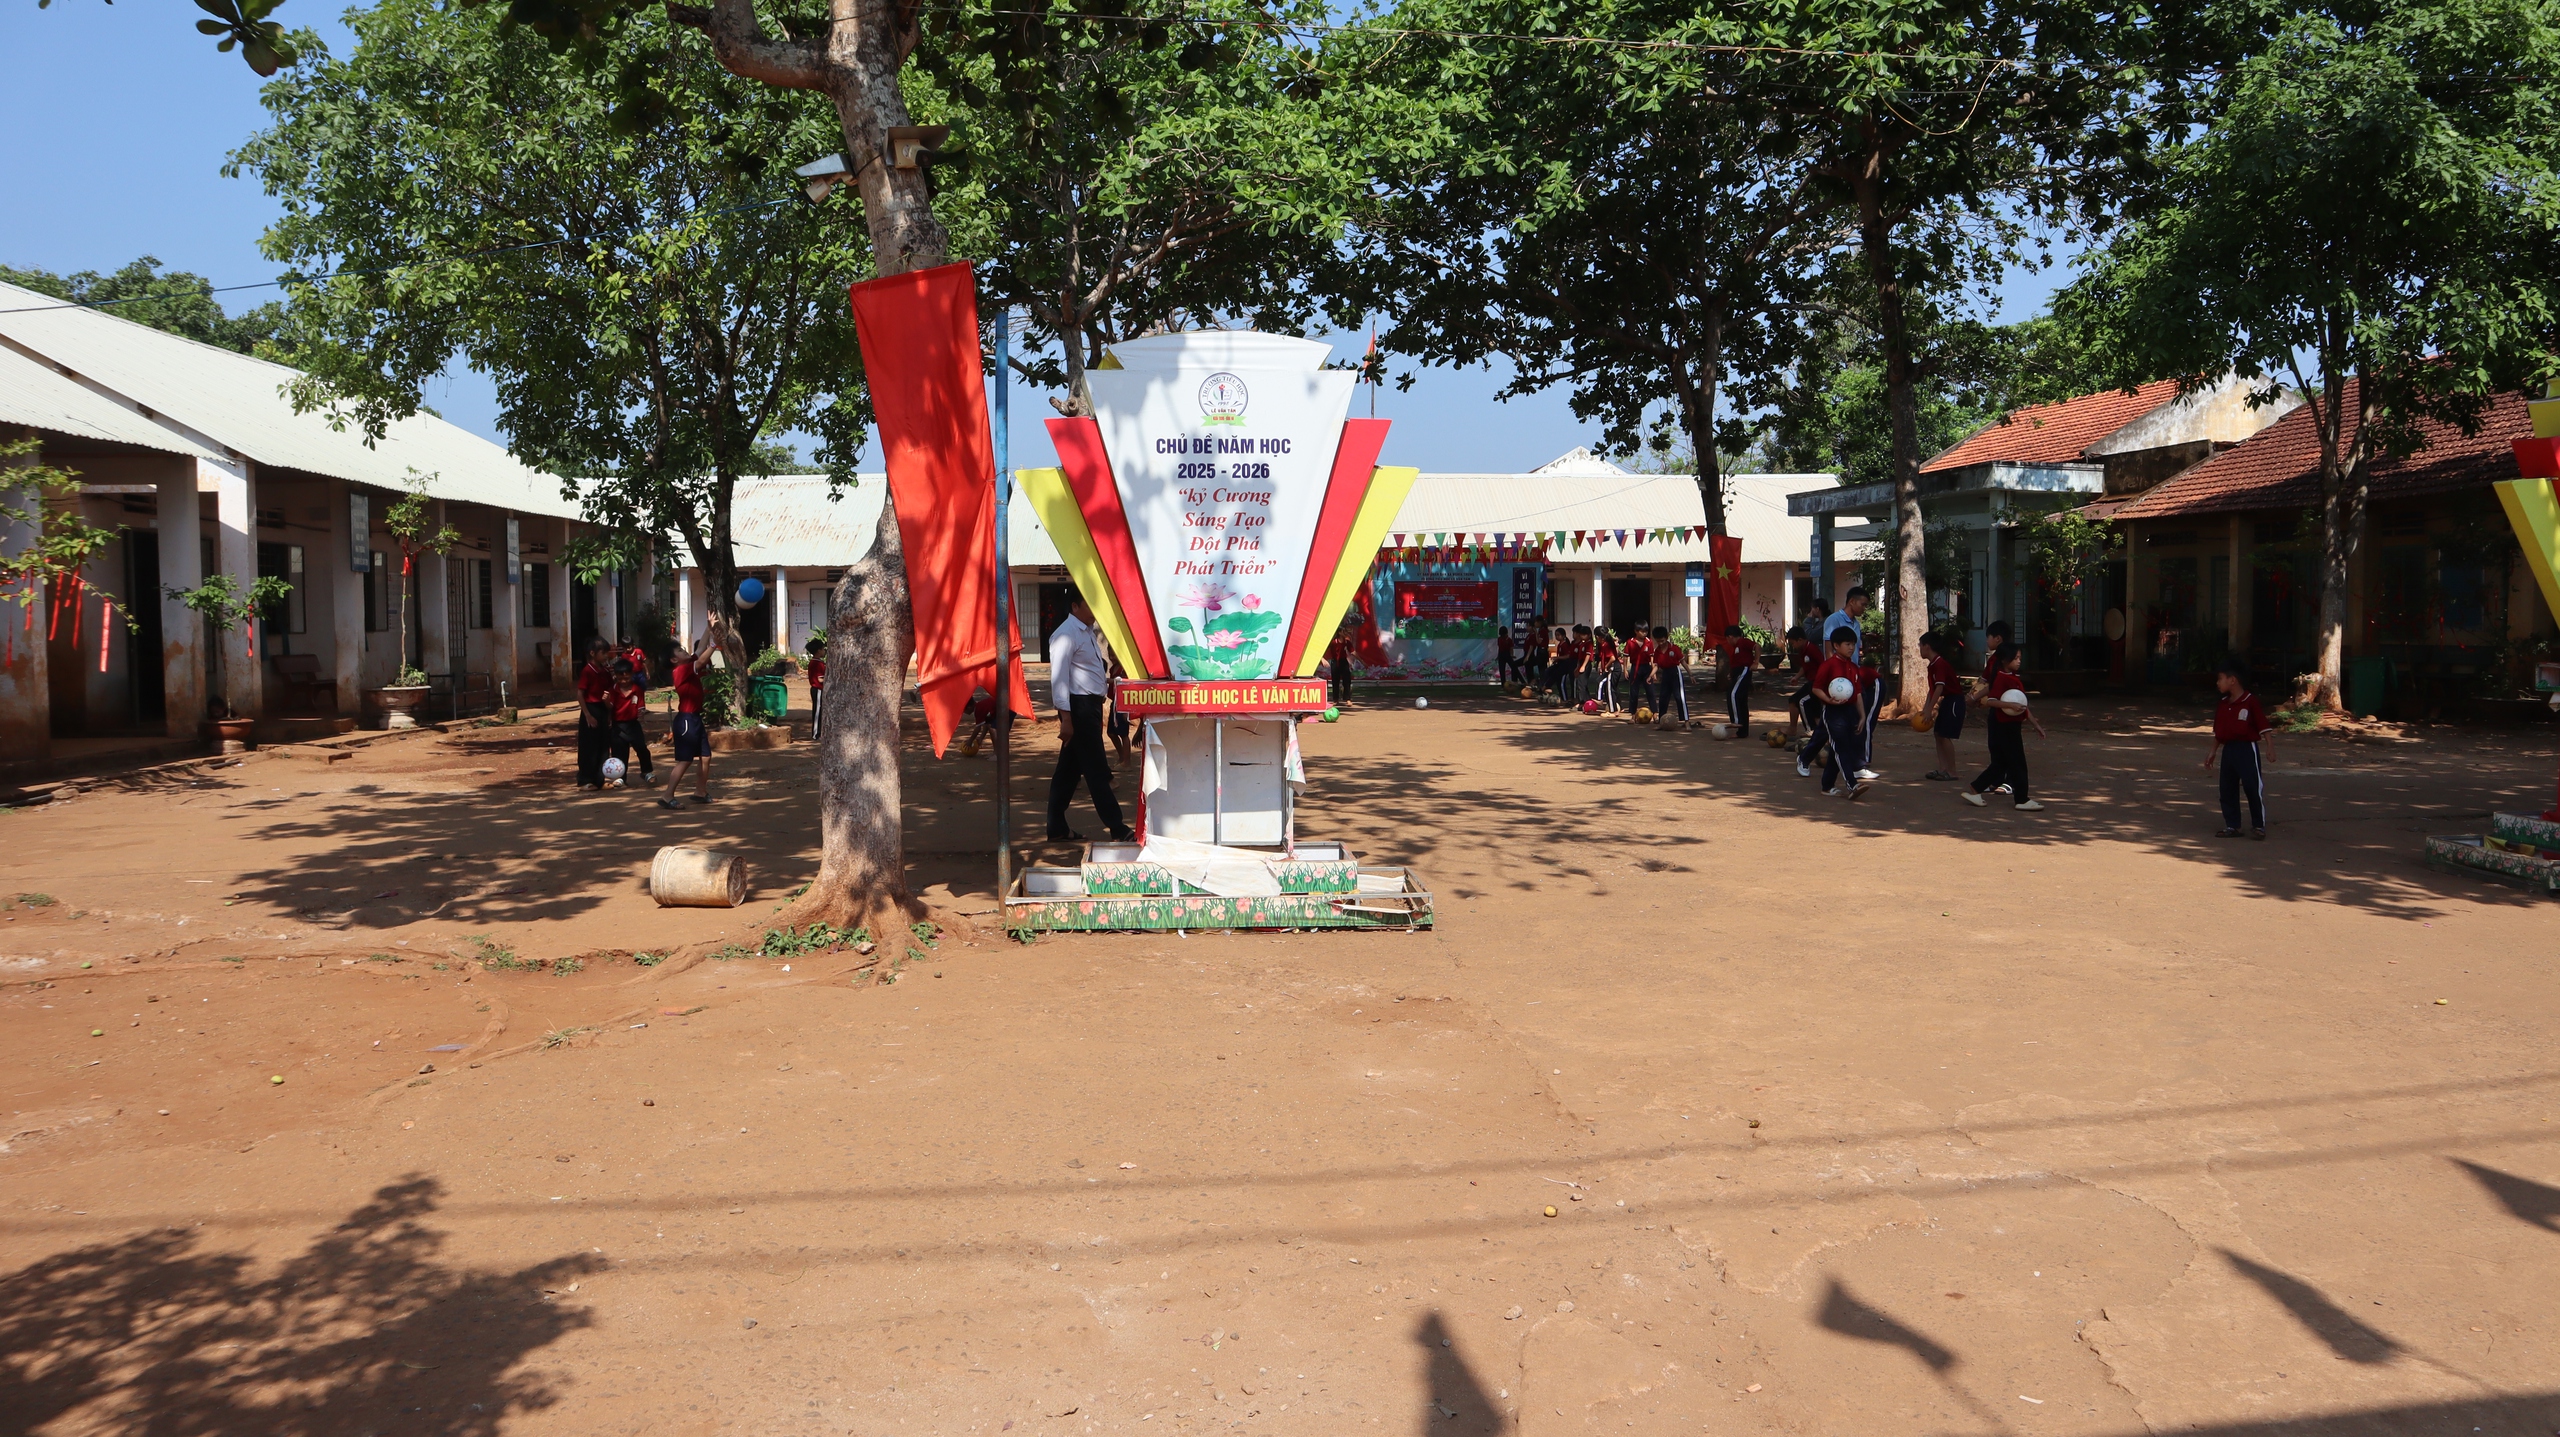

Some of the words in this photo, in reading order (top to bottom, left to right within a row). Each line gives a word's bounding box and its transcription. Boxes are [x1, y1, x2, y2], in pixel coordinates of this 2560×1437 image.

[1156, 433, 1188, 454] CHỦ
[1192, 433, 1213, 454] ĐỀ
[1218, 435, 1254, 454] NĂM
[1260, 438, 1291, 457] HỌC
[1177, 463, 1216, 479] 2025
[1232, 463, 1270, 479] 2026
[1212, 487, 1272, 507] Cương
[1182, 511, 1228, 531] Sáng
[1234, 511, 1266, 531] Tạo
[1189, 535, 1221, 555] Đột
[1225, 535, 1260, 551] Phá
[1173, 560, 1215, 575] Phát
[1122, 686, 1176, 705] TRƯỜNG
[1179, 684, 1208, 705] TIỂU
[1212, 688, 1239, 708] HỌC
[1243, 686, 1259, 705] LÊ
[1261, 685, 1289, 704] VĂN
[1292, 686, 1321, 704] TÁM
